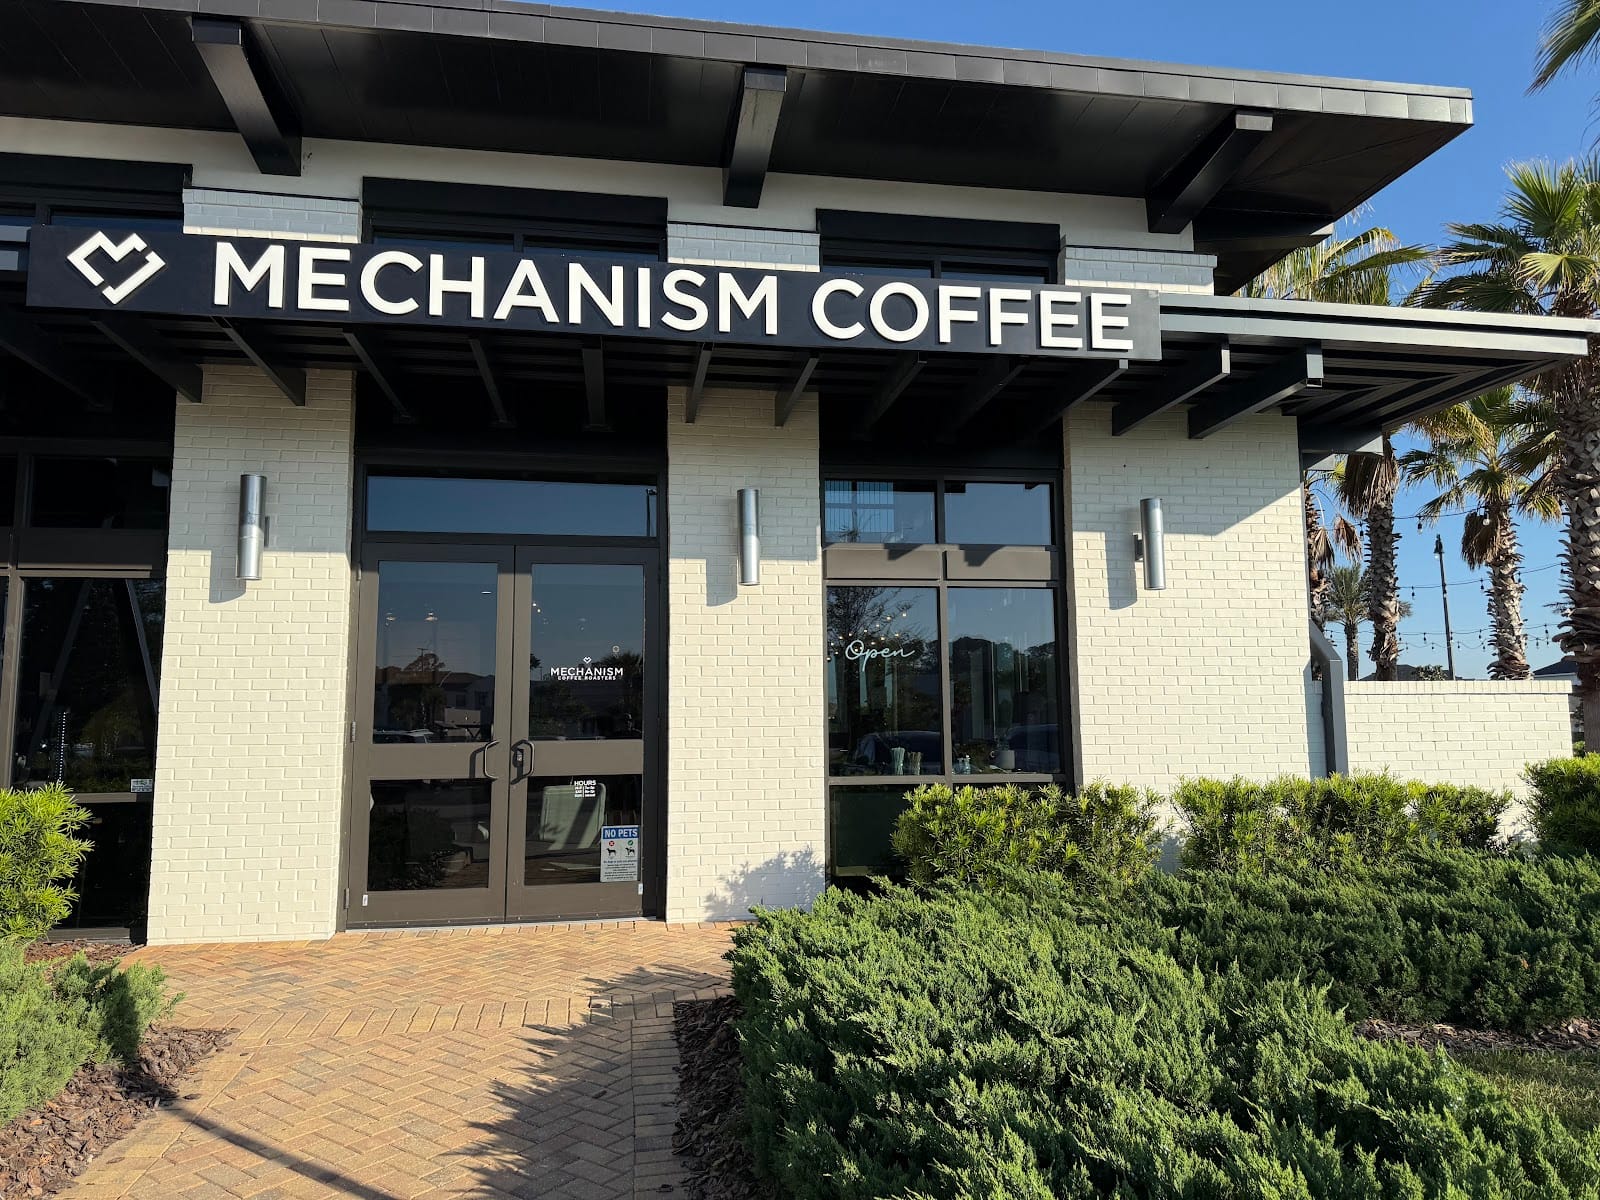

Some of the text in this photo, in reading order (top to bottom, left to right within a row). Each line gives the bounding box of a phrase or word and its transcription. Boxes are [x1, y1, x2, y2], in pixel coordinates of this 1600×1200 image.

[213, 241, 1134, 350] MECHANISM COFFEE
[845, 639, 915, 672] Open
[550, 667, 624, 676] MECHANISM
[604, 828, 638, 838] NO PETS
